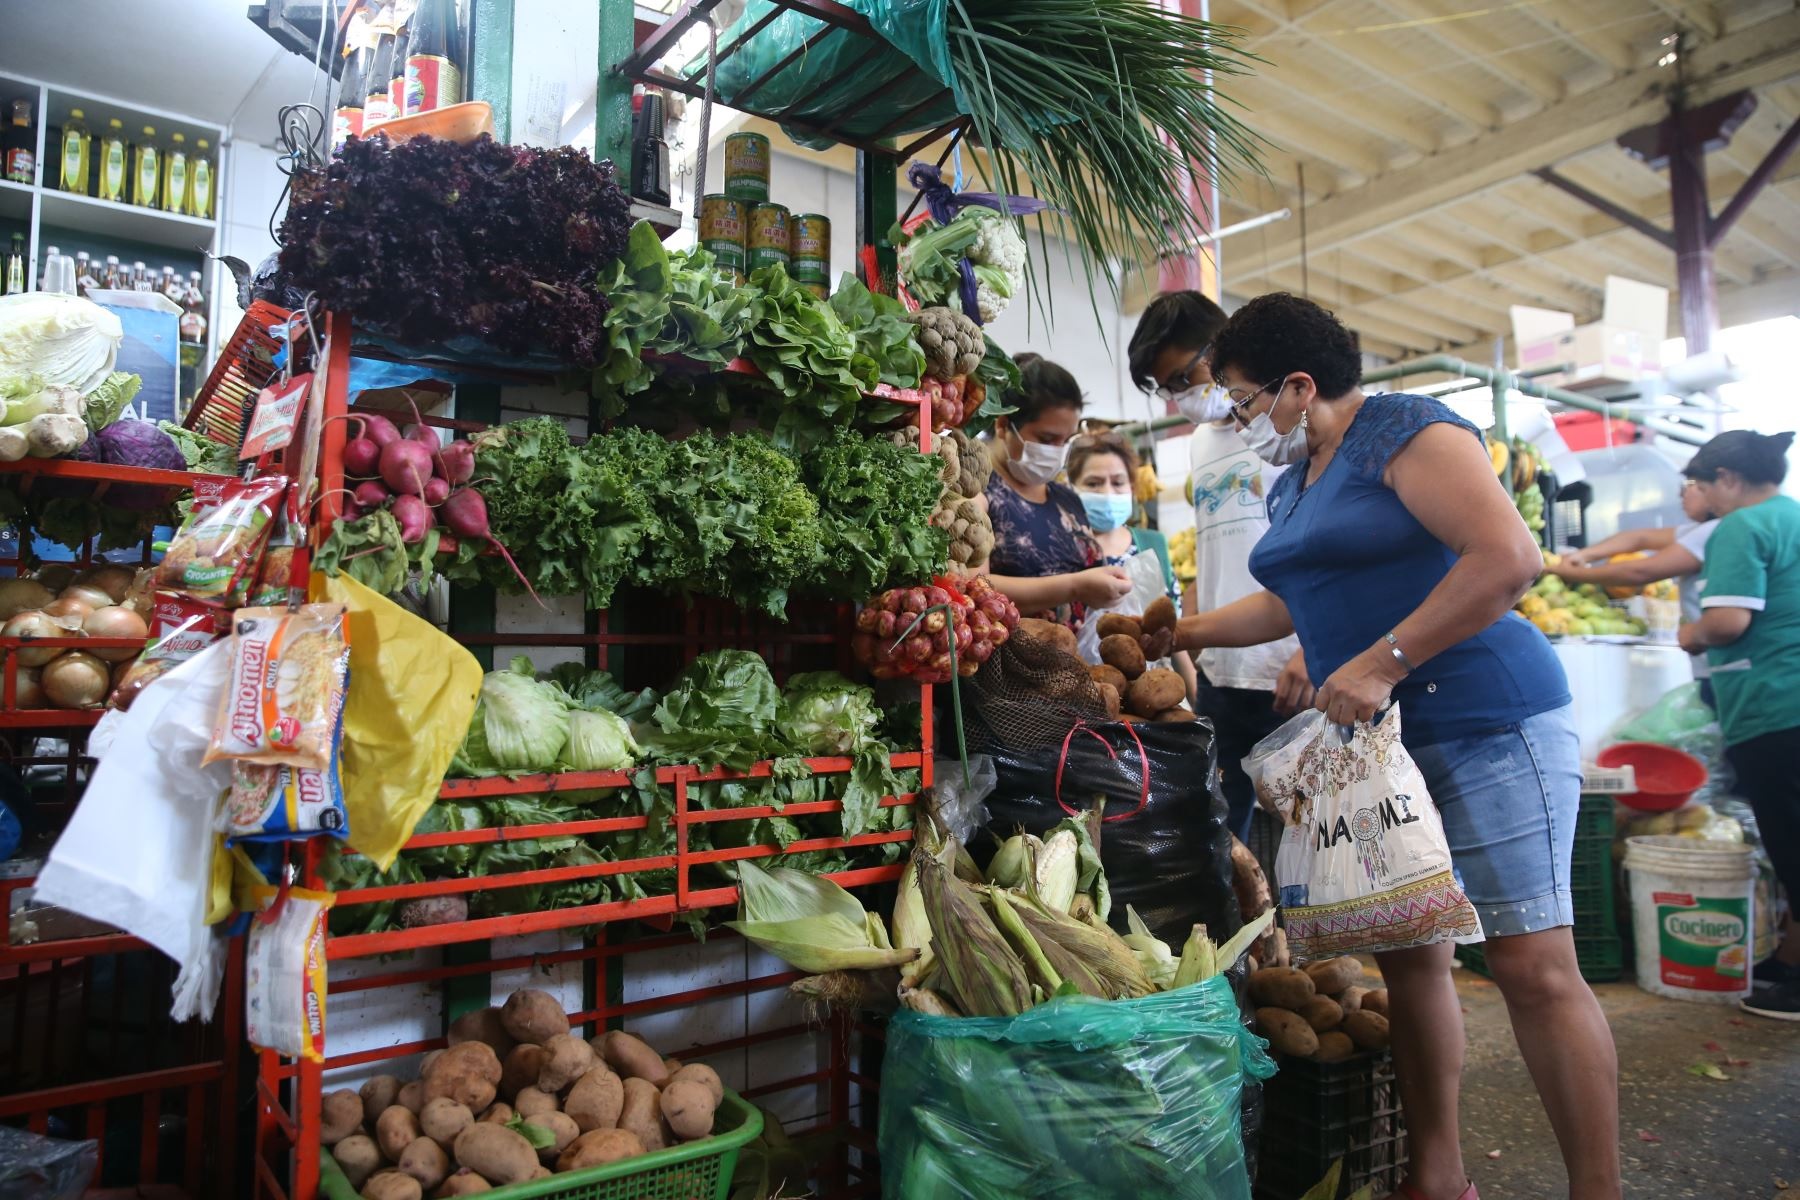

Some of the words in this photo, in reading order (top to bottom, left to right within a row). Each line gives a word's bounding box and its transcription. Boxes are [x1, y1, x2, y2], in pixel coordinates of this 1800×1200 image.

[266, 660, 280, 689] POLLO
[1316, 794, 1420, 852] NAOMI
[1670, 917, 1740, 937] Cocinero
[306, 991, 321, 1035] GALLINA
